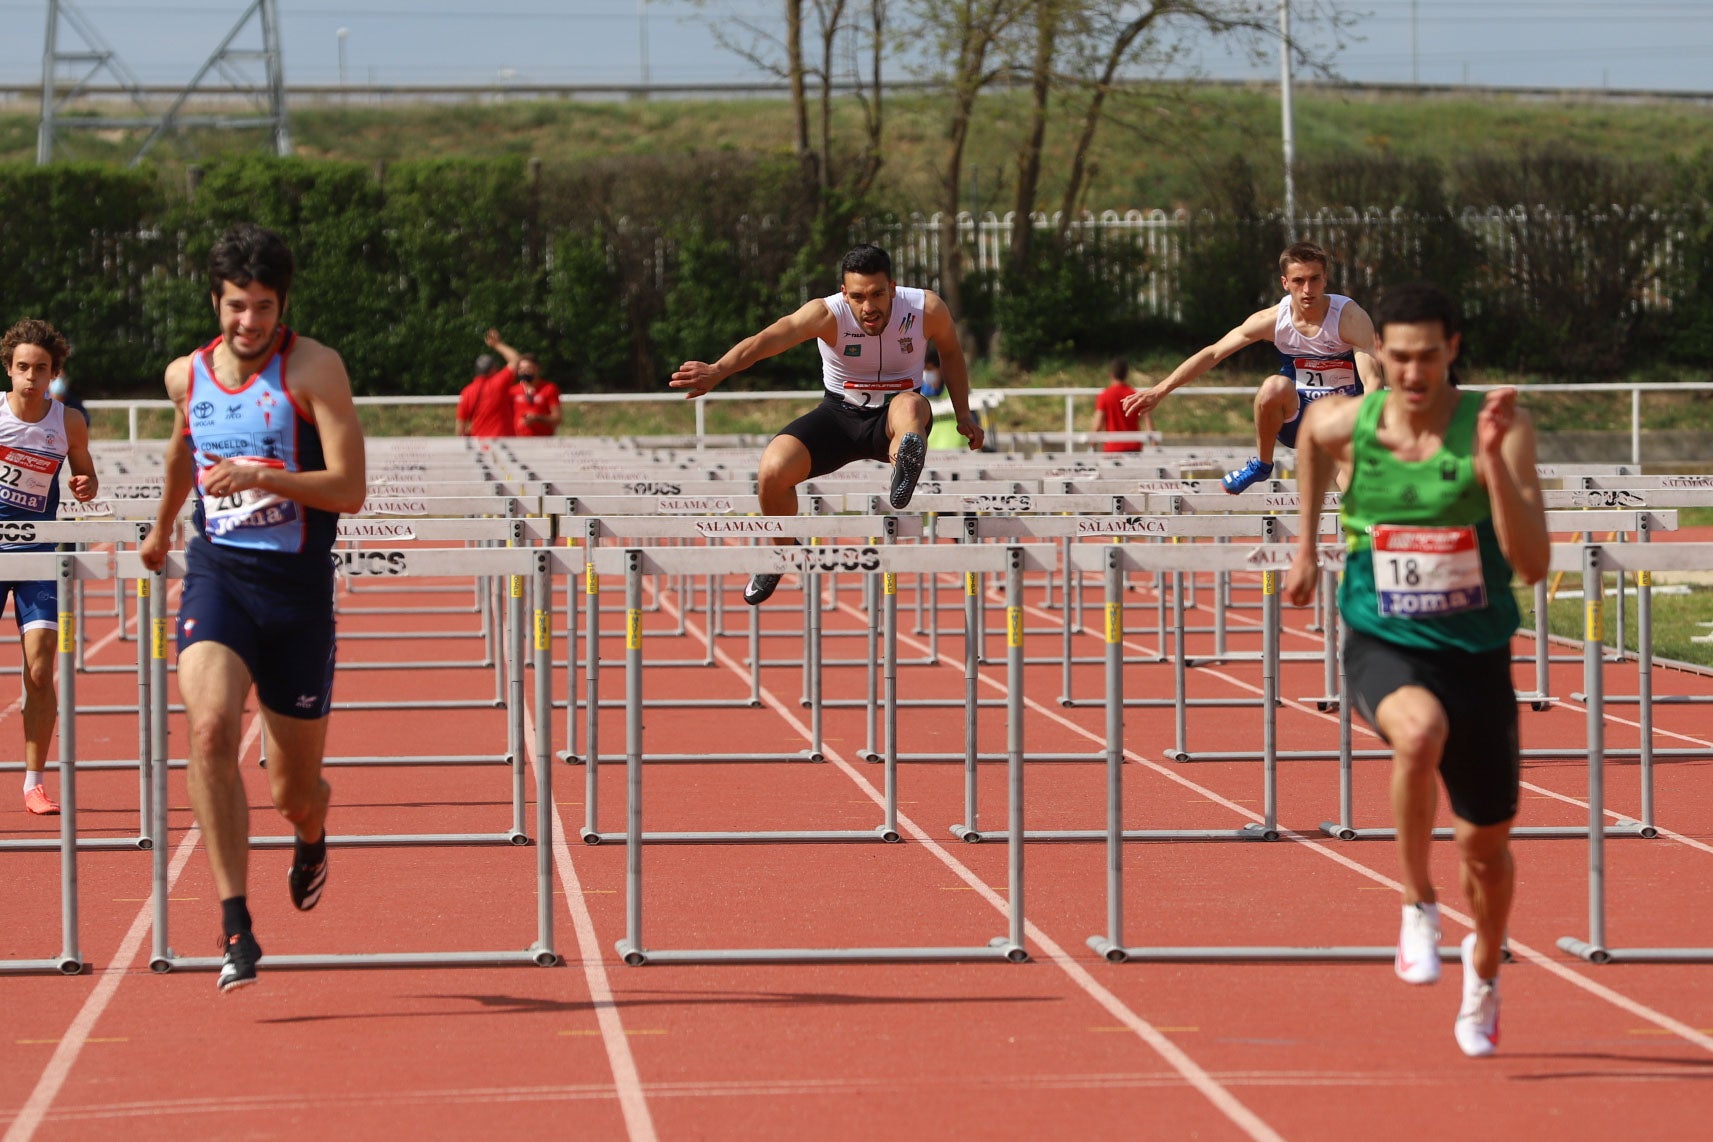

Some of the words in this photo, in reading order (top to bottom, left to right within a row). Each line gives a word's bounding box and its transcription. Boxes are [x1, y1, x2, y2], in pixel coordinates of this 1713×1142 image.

[1306, 371, 1324, 387] 21
[200, 440, 248, 451] CONCELLO
[0, 465, 22, 487] 22
[0, 487, 38, 507] oma
[361, 502, 426, 511] ALAMANCA
[659, 500, 732, 510] SALAMACA
[337, 525, 413, 536] ALAMANCA
[697, 521, 783, 533] SALAMANCA
[1078, 521, 1166, 533] SALAMANCA
[1388, 558, 1420, 586] 18
